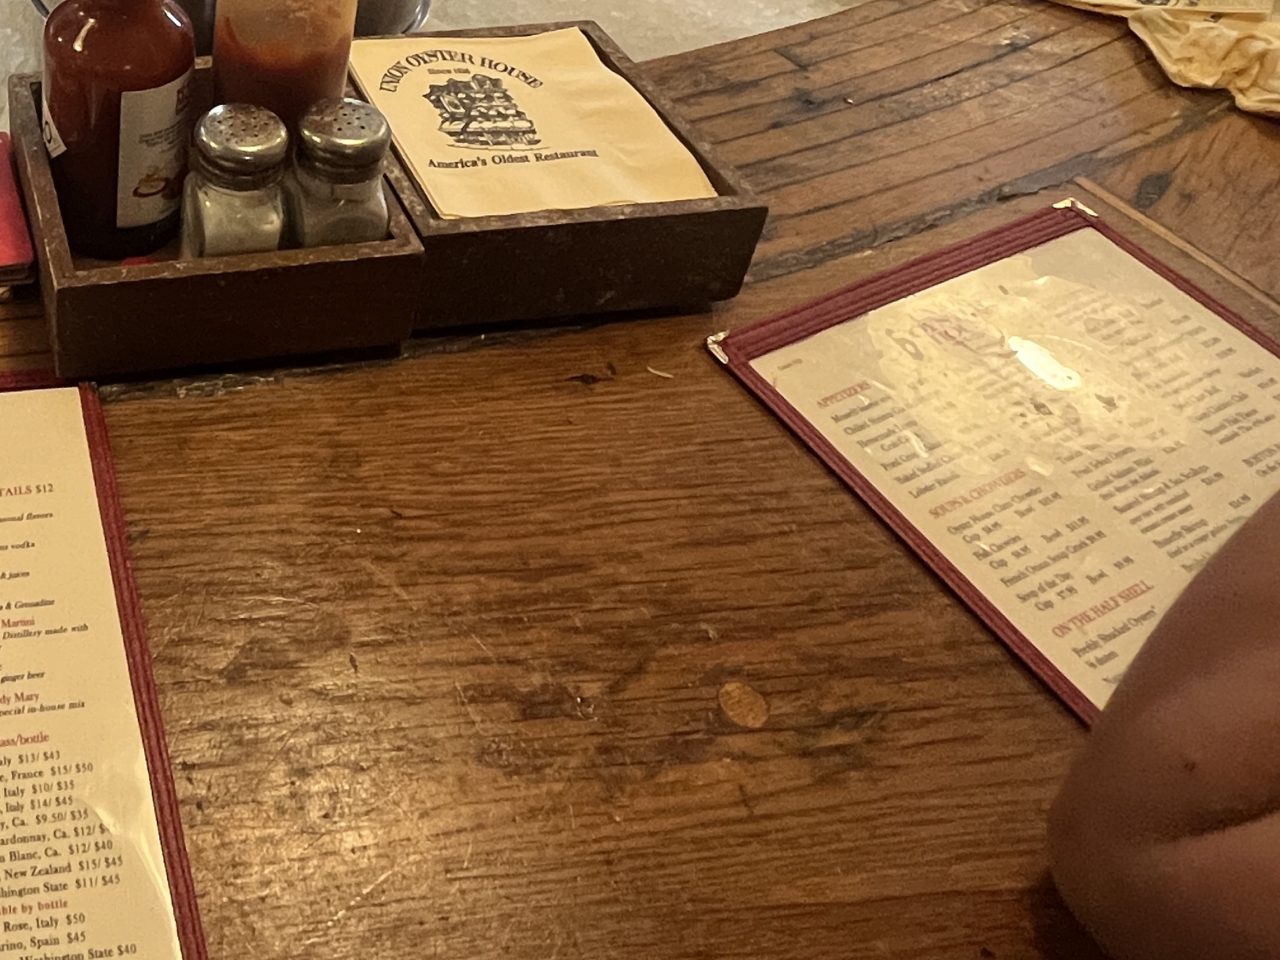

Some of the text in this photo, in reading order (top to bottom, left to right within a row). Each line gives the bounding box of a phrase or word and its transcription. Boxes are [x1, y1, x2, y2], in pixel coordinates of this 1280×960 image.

[379, 49, 544, 92] UNION OYSTER HOUSE
[428, 149, 600, 170] America's Oldest Restaurant
[35, 484, 54, 494] $12
[928, 495, 963, 519] SOUPS
[1052, 580, 1154, 638] ON THE HALF SHELL
[1, 618, 36, 628] Martini
[14, 692, 40, 707] Mary
[9, 850, 41, 862] Blanc,
[94, 840, 113, 854] $40
[4, 869, 26, 881] New
[30, 862, 72, 877] Zealand
[104, 855, 122, 869] $45
[43, 882, 68, 893] State
[102, 874, 120, 887] $45
[4, 921, 32, 933] Rose,
[36, 916, 59, 930] Italy
[66, 913, 86, 926] $50
